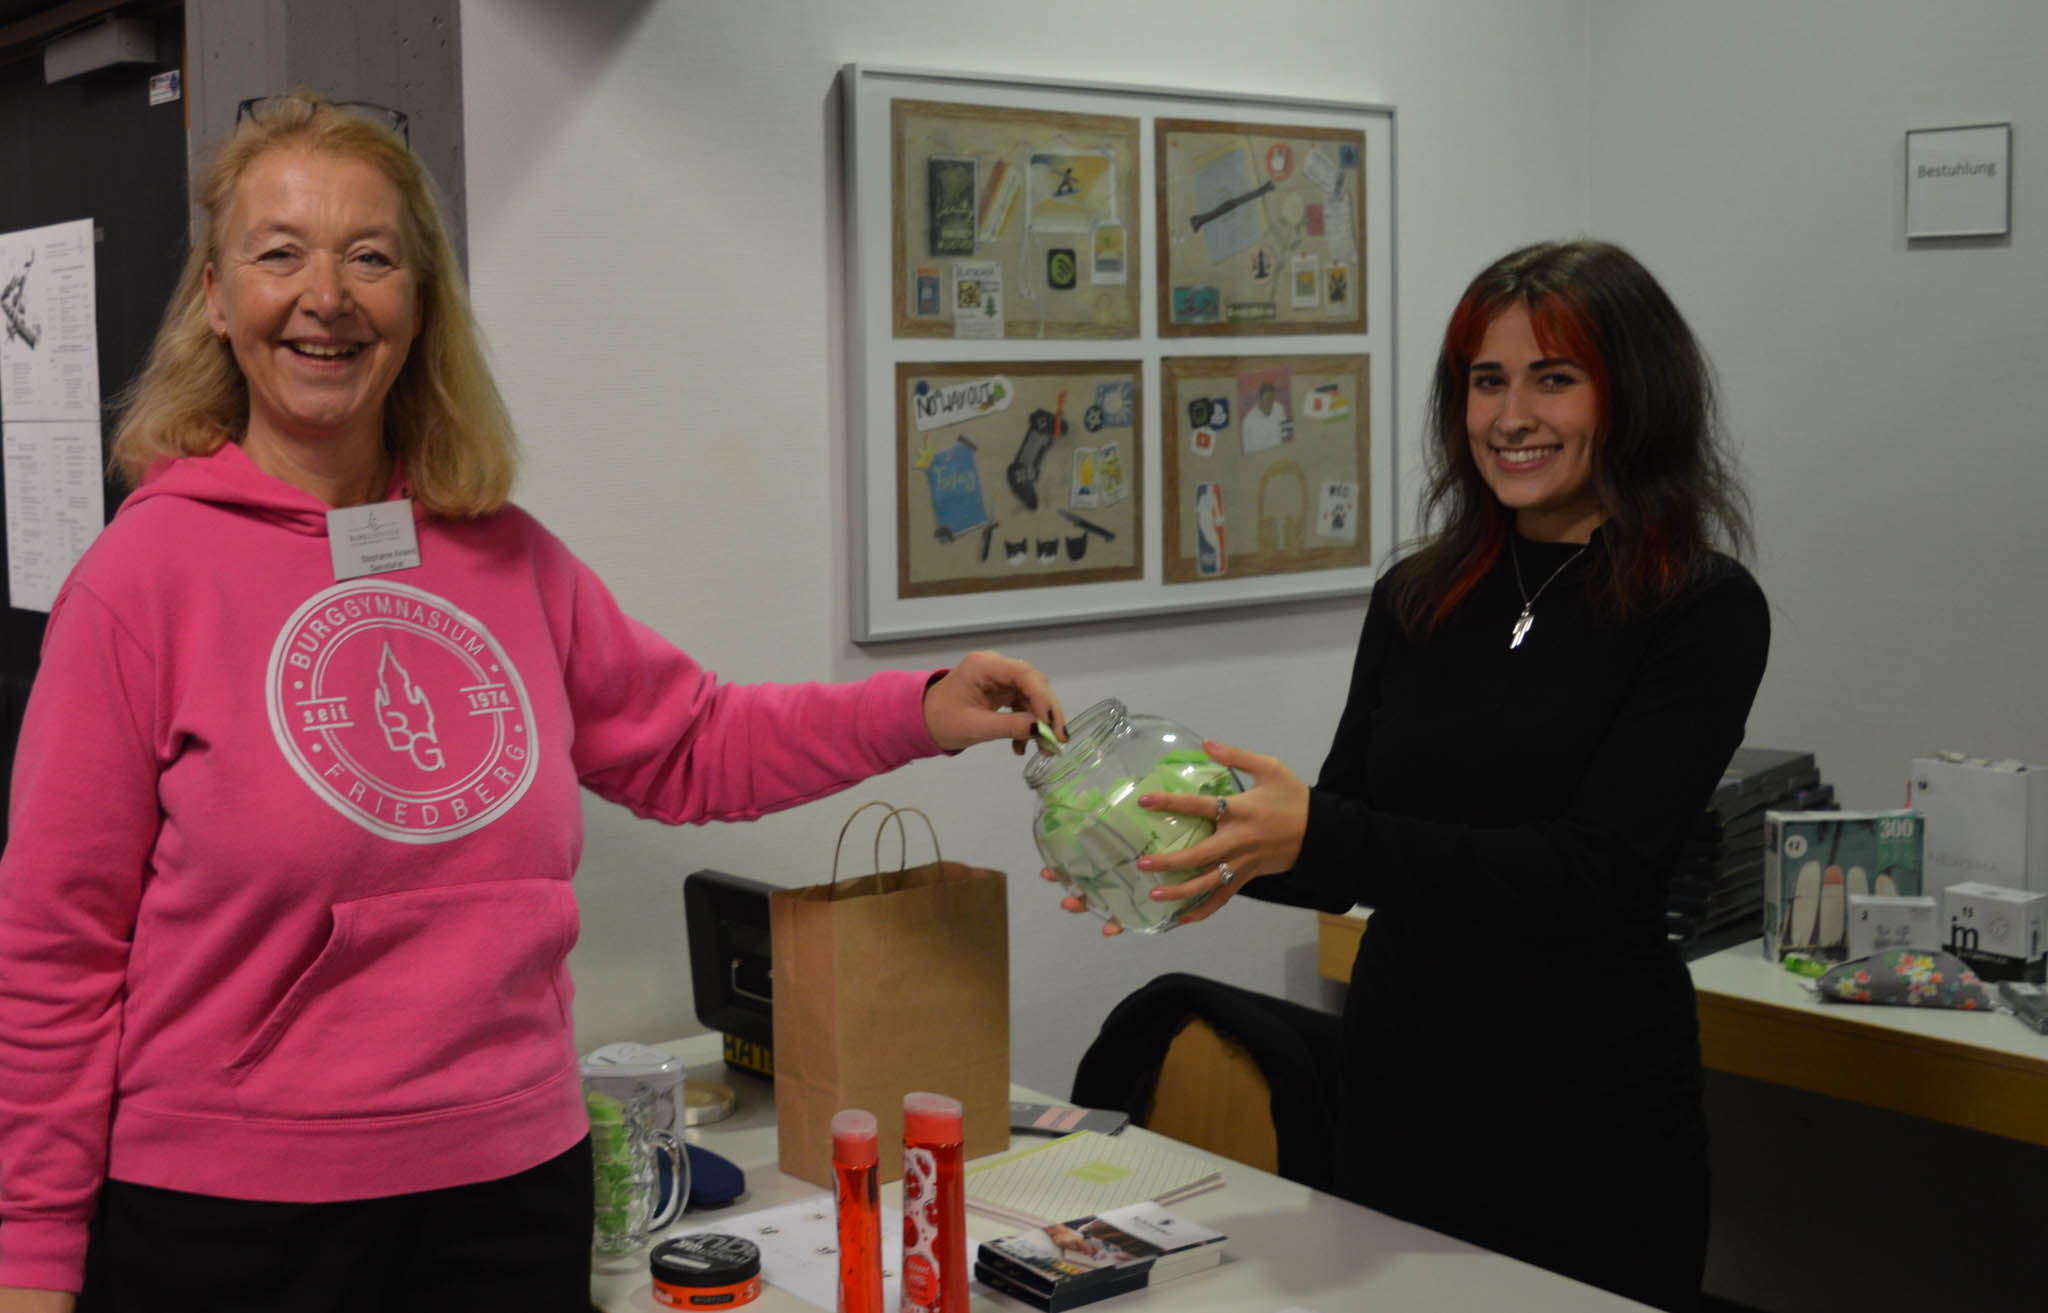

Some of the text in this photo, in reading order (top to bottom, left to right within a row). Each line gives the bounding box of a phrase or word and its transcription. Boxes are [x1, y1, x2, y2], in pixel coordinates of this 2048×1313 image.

[1918, 161, 1996, 179] Bestuhlung
[917, 382, 991, 419] NO WAY OUT
[289, 594, 485, 670] BURGGYMNASIUM
[469, 690, 510, 709] 1974
[303, 703, 349, 724] seit
[324, 743, 526, 827] FRIEDBERG
[1880, 818, 1915, 839] 300
